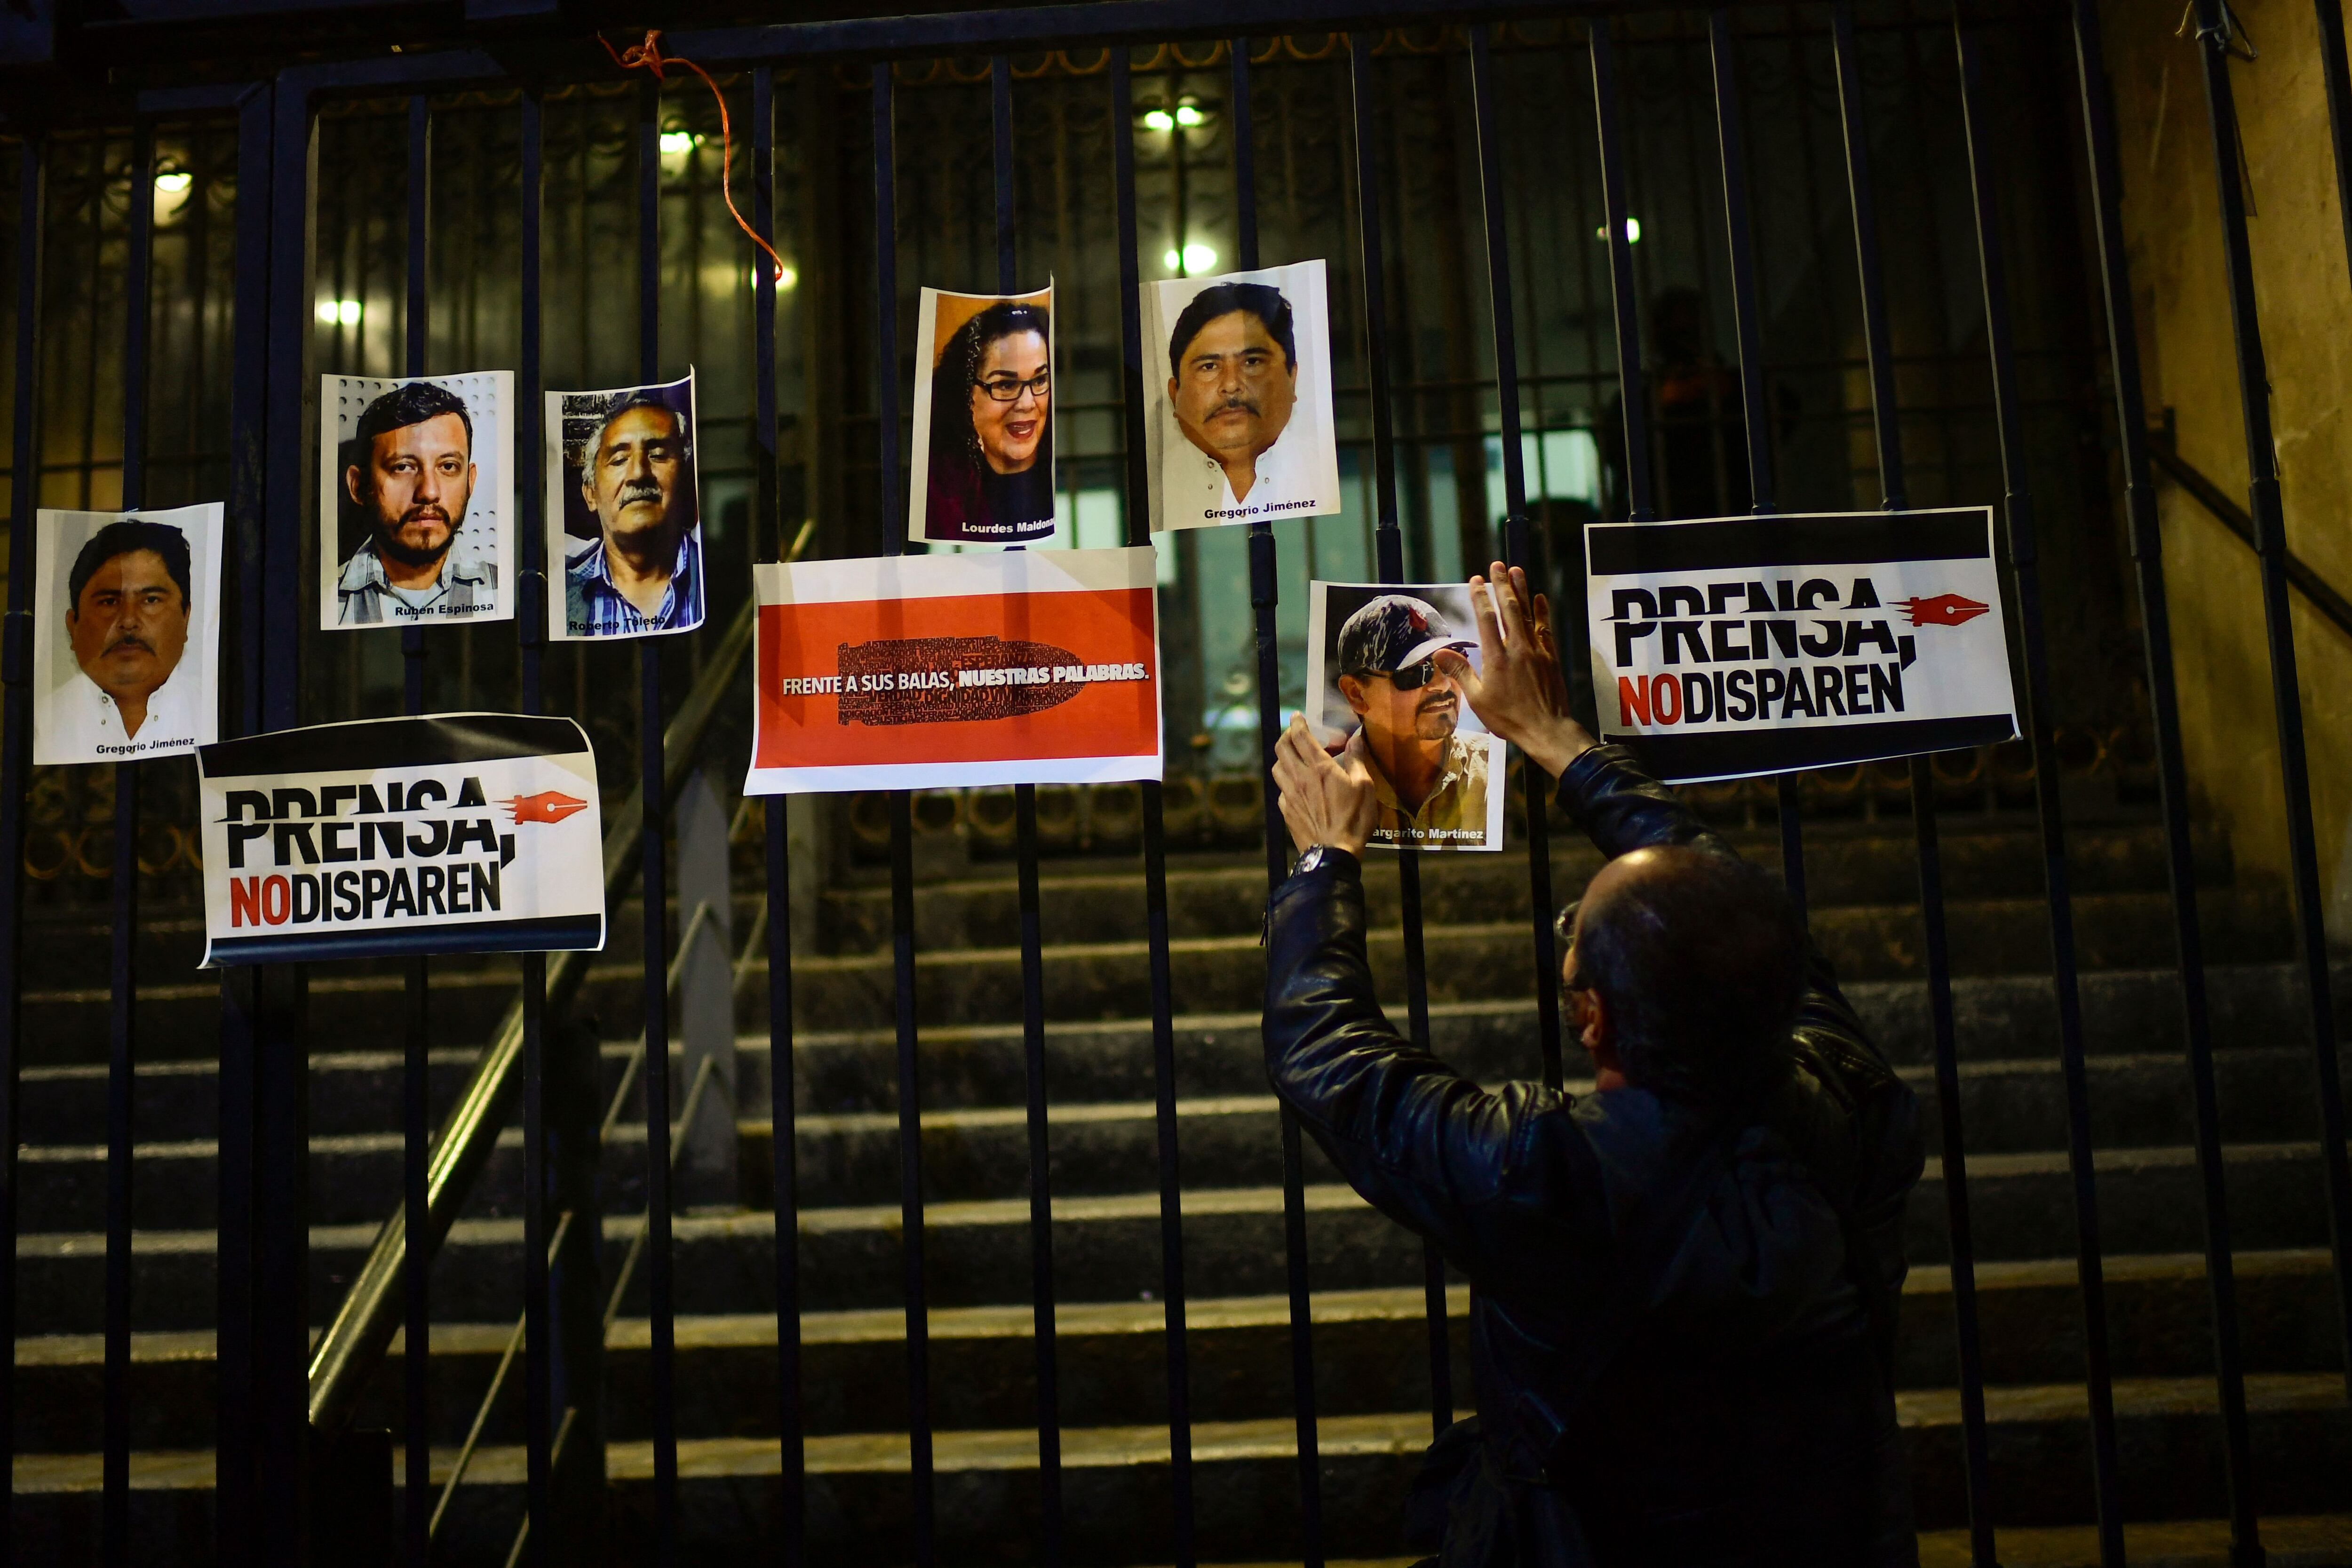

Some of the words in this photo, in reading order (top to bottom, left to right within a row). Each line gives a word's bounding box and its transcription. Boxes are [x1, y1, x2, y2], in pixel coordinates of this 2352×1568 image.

[1204, 506, 1259, 519] Gregorio
[1263, 500, 1316, 513] Jiménez
[962, 522, 1013, 533] Lourdes
[1017, 517, 1054, 533] Maldona
[395, 606, 434, 616] Rubén
[438, 603, 494, 615] Espinosa
[569, 621, 620, 630] Roberto
[624, 615, 666, 627] Toledo
[1600, 578, 1917, 672] PRENSA,
[783, 676, 842, 695] FRENTE
[846, 675, 858, 692] A
[861, 674, 894, 692] SUS
[898, 671, 955, 692] BALAS,
[958, 667, 1050, 688] NUESTRAS
[1053, 662, 1150, 684] PALABRAS.
[96, 742, 146, 755] Gregorio
[150, 738, 195, 749] Jiménez
[214, 777, 515, 870] PRENSA,
[1373, 828, 1424, 840] argarito
[1429, 828, 1484, 839] Martínez
